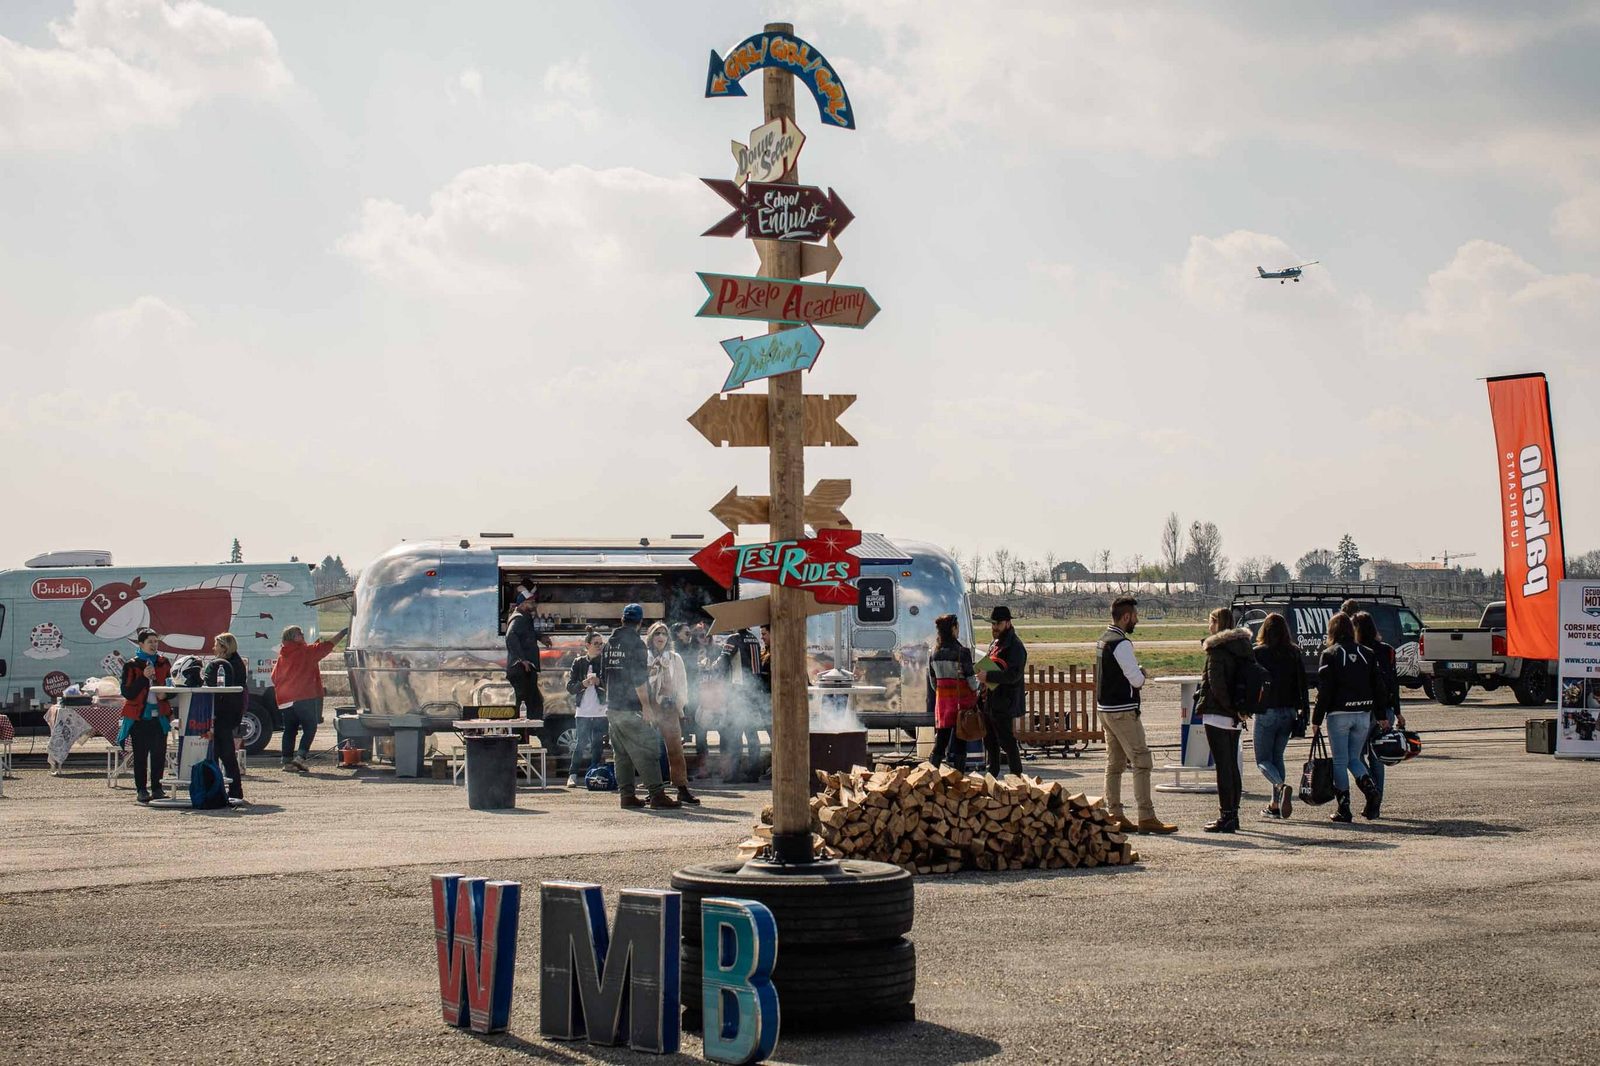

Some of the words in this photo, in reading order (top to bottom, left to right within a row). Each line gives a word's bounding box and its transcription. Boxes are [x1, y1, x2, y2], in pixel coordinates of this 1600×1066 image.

[764, 191, 800, 213] School
[717, 278, 780, 315] Pakelo
[782, 285, 866, 323] Academy
[723, 541, 798, 577] TEST
[779, 548, 850, 587] RIDES
[36, 582, 87, 596] Bustaffa
[1297, 634, 1322, 649] Racing
